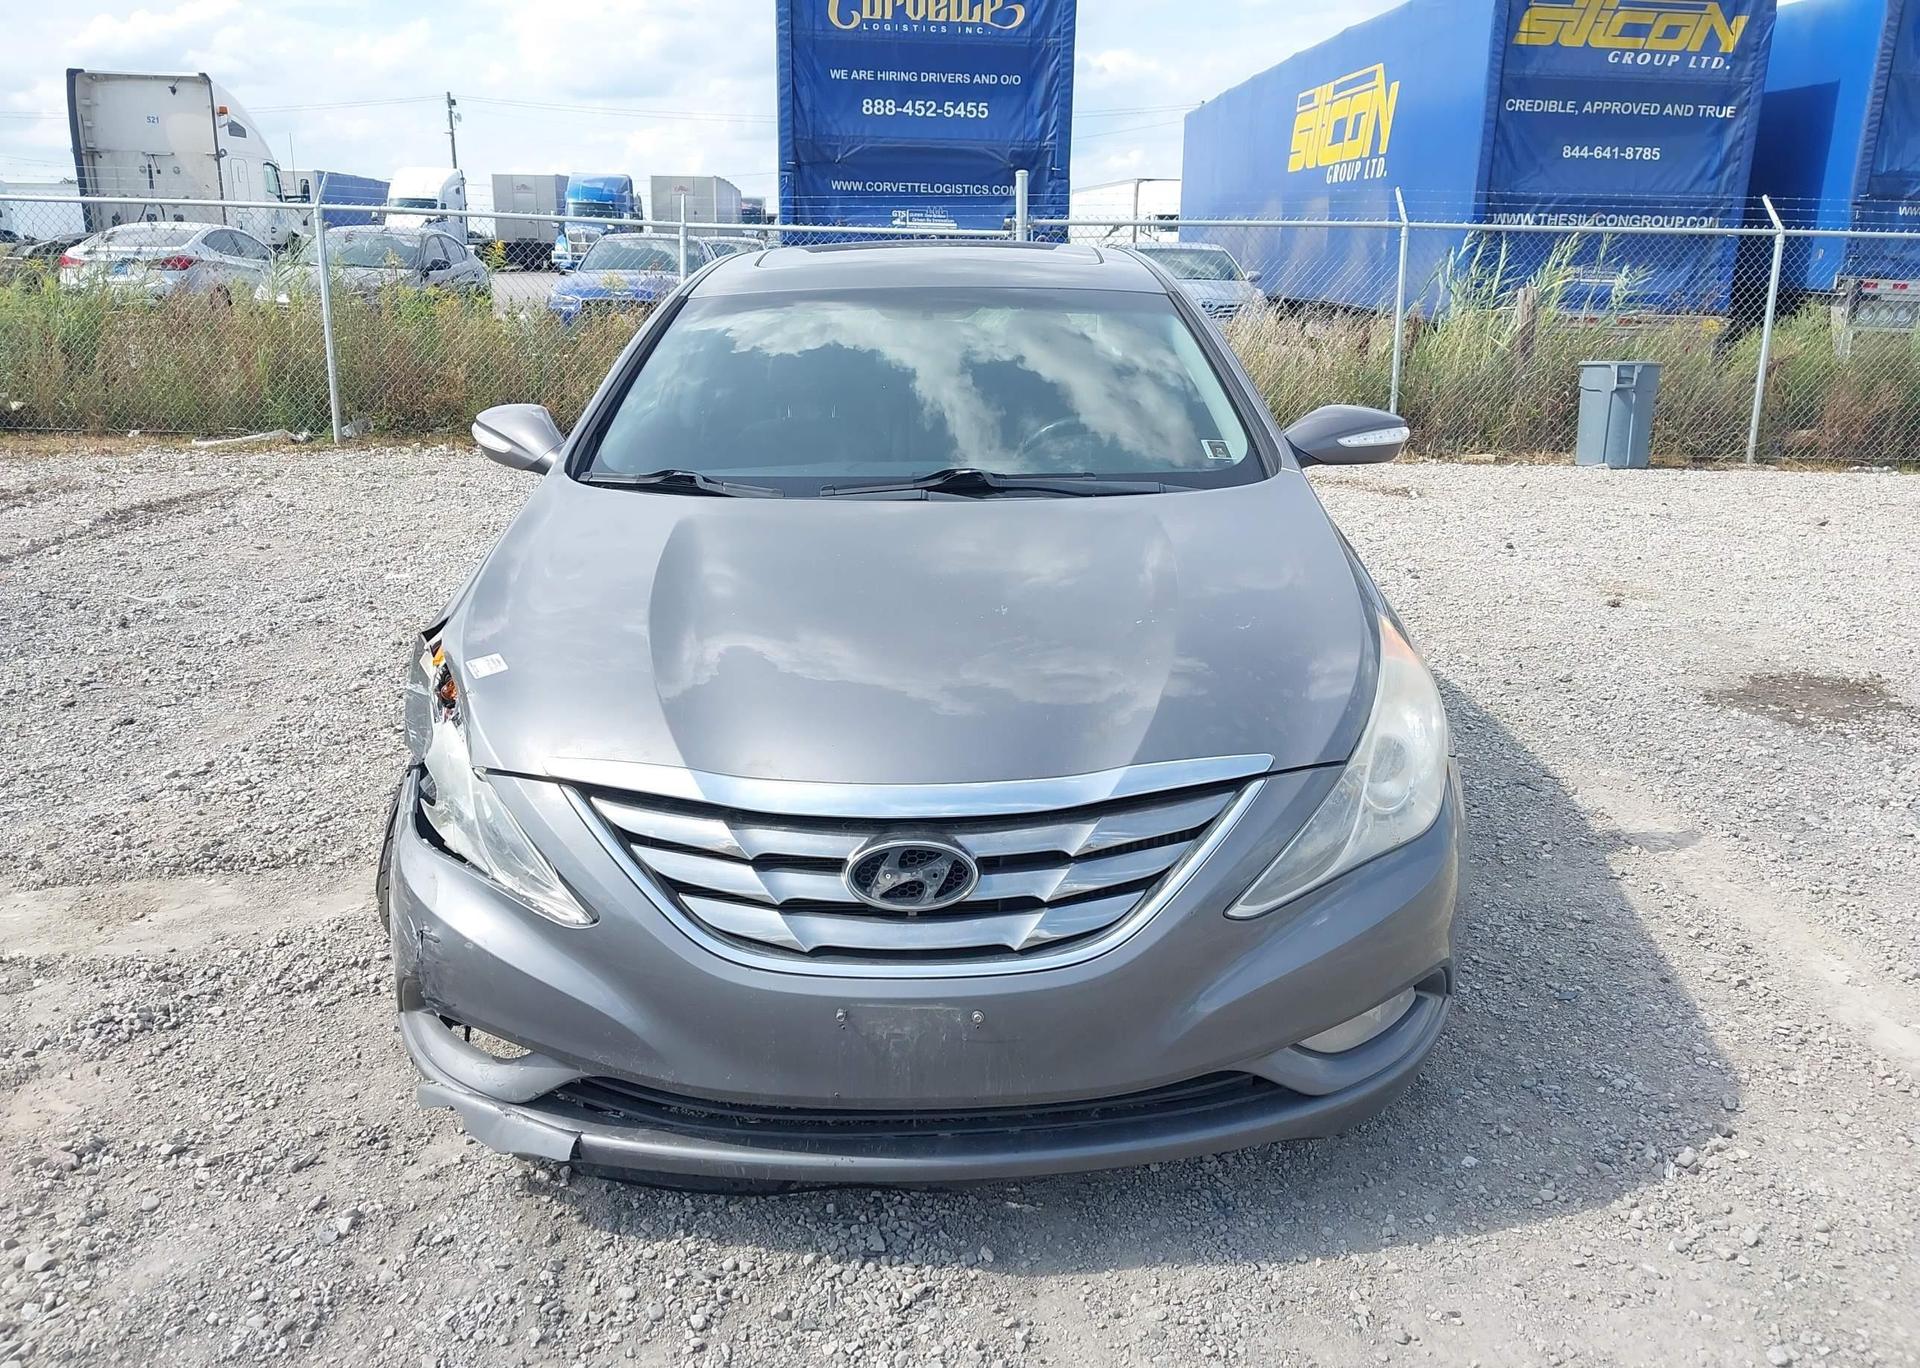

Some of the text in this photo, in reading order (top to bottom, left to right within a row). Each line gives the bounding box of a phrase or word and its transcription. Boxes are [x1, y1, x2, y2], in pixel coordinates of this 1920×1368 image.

[862, 23, 992, 35] LOGISTICS INC.
[1608, 51, 1731, 70] GROUP LTD.
[830, 69, 1022, 86] WE ARE HIRING DRIVERS AND O/O
[862, 98, 989, 119] 888-452-5455
[1505, 98, 1737, 118] CREDIBLE, APPROVED AND TRUE
[146, 115, 160, 124] 521
[1562, 145, 1661, 161] 844-641-8785
[1326, 157, 1388, 184] GROUP LTD.
